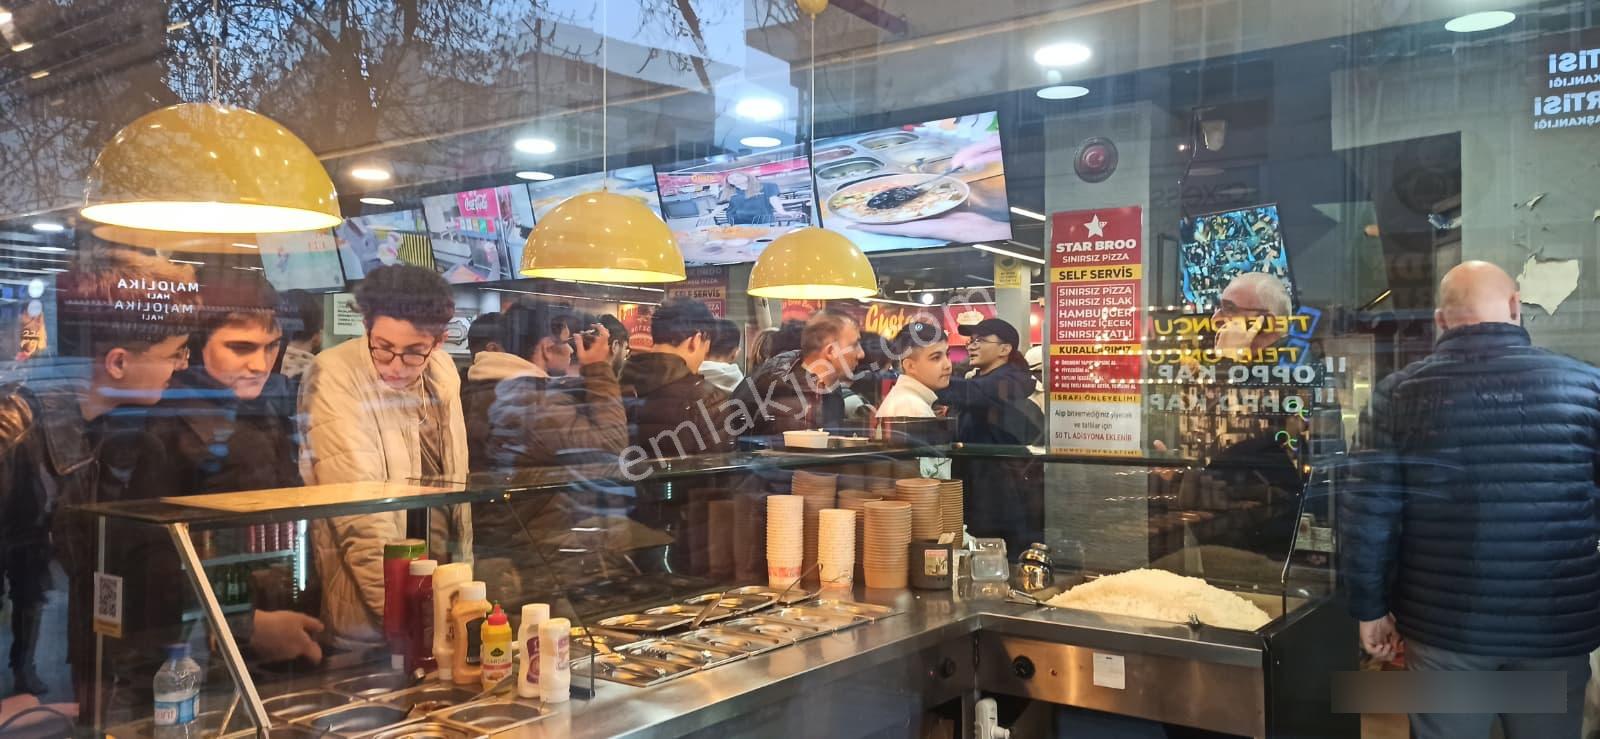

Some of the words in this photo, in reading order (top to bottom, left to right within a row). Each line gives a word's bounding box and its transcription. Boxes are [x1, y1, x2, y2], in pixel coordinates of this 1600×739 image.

[1056, 241, 1092, 253] STAR
[1095, 239, 1137, 251] BROO
[1062, 254, 1100, 263] SINIRSIZ
[1059, 270, 1087, 280] SELF
[1090, 266, 1133, 279] SERVİS
[1059, 287, 1100, 296] SINIRSIZ
[1059, 298, 1100, 306] SINIRSIZ
[1059, 319, 1097, 328] SINIRSIZ
[1098, 317, 1132, 328] İÇECEK
[1059, 330, 1101, 339] SINIRSIZ
[1102, 329, 1132, 339] TATLI
[1064, 431, 1071, 439] TL
